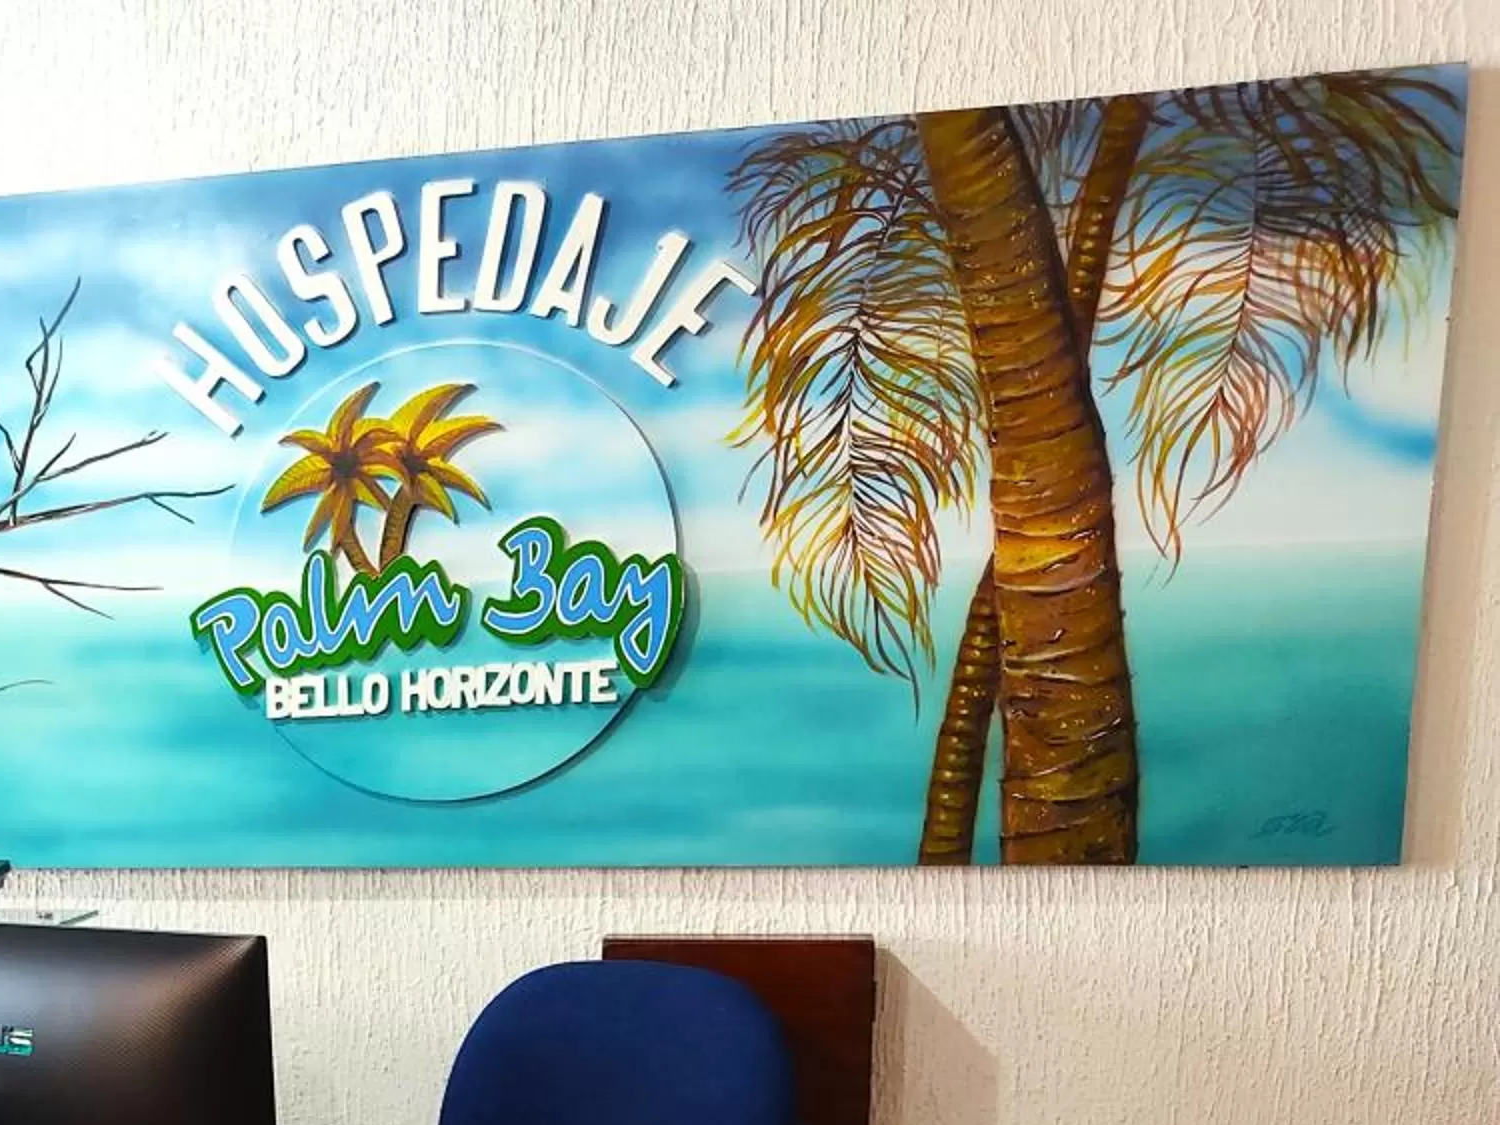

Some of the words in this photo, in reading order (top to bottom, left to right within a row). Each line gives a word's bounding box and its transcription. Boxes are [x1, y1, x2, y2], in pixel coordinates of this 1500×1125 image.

[152, 178, 756, 435] HOSPEDAJE
[193, 551, 470, 693] Palm
[481, 516, 682, 687] Bay
[266, 676, 387, 719] BELLO
[402, 661, 619, 713] HORIZONTE
